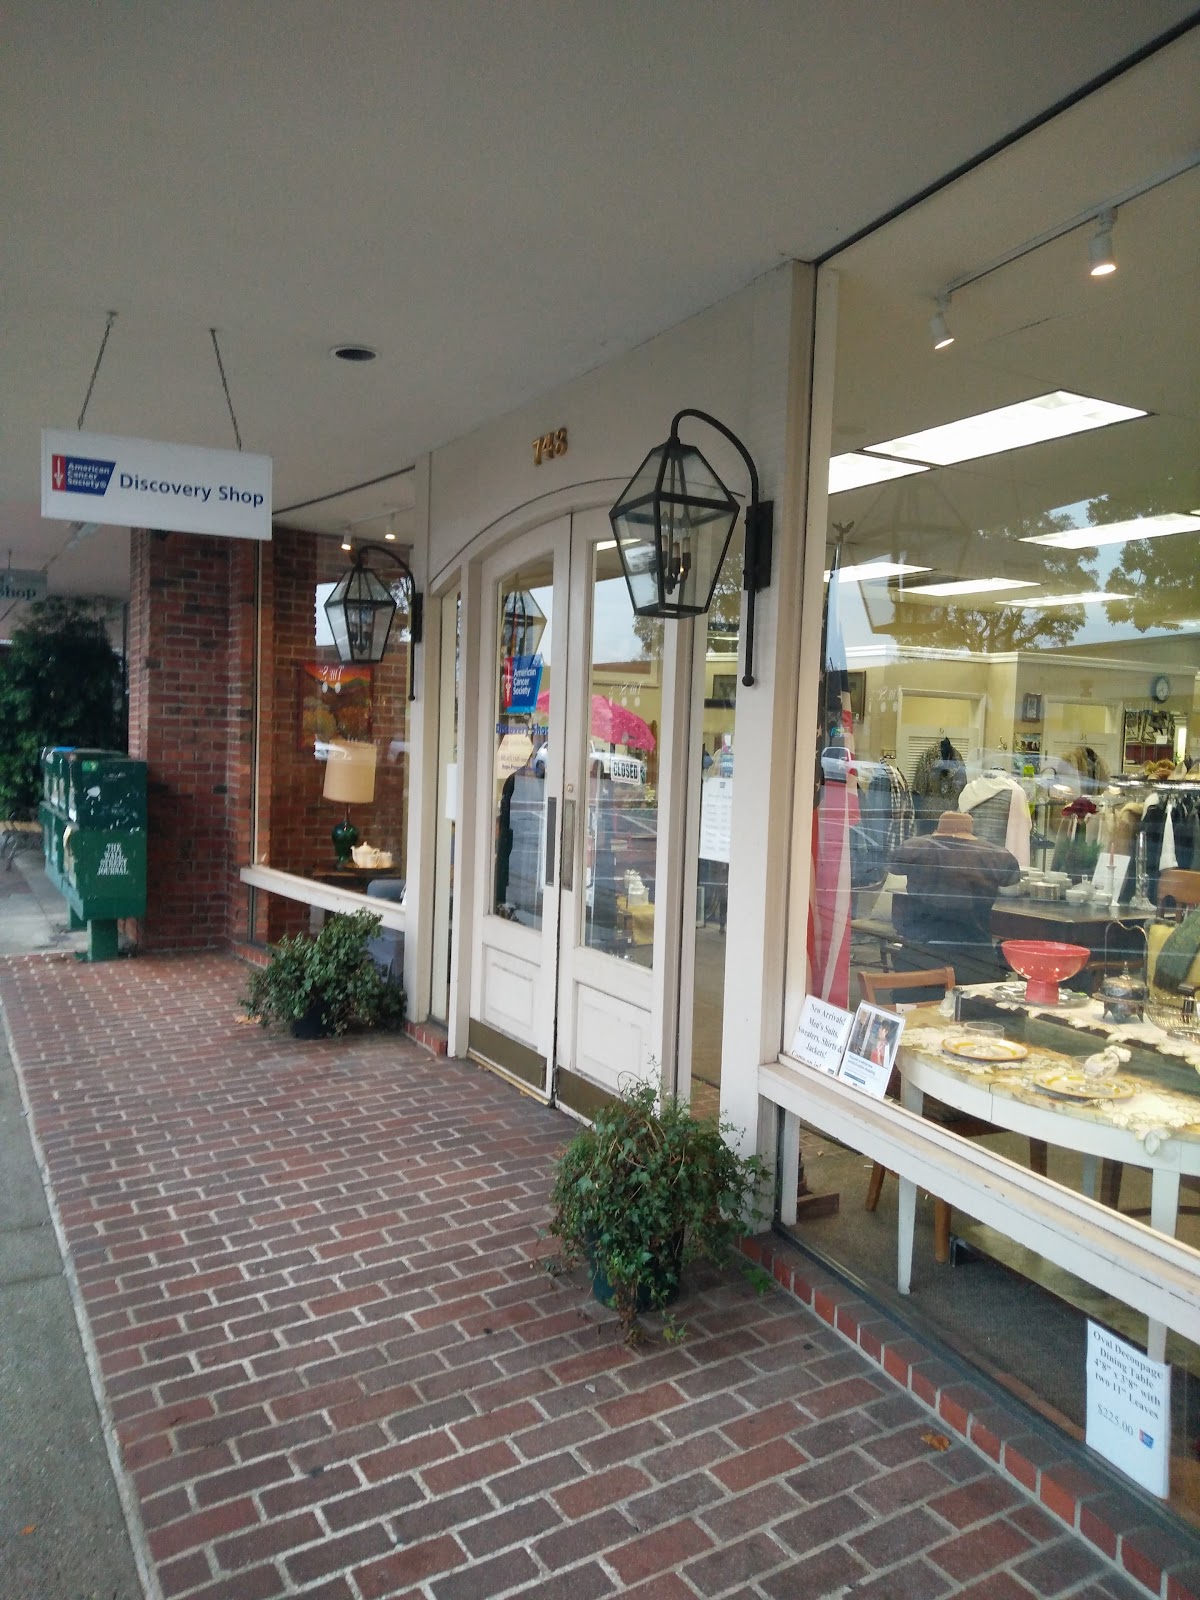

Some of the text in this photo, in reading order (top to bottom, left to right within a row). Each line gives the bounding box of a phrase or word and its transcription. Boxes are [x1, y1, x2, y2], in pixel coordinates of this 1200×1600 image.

[67, 461, 110, 475] American
[67, 470, 98, 481] Cancer
[120, 473, 264, 509] Discovery Shop
[513, 667, 537, 678] American
[513, 677, 530, 687] Cancer
[512, 686, 531, 698] Society
[613, 761, 638, 780] CLOSED
[106, 842, 122, 852] THE
[104, 850, 124, 860] WALL
[810, 1003, 821, 1014] New
[809, 1017, 824, 1030] Men's
[1093, 1330, 1163, 1379] Oval Decoupage
[1100, 1347, 1154, 1390] Dining Table
[1095, 1372, 1110, 1387] two
[1128, 1393, 1159, 1420] Leaves
[1141, 1388, 1161, 1407] with
[1097, 1403, 1134, 1437] $225.00
